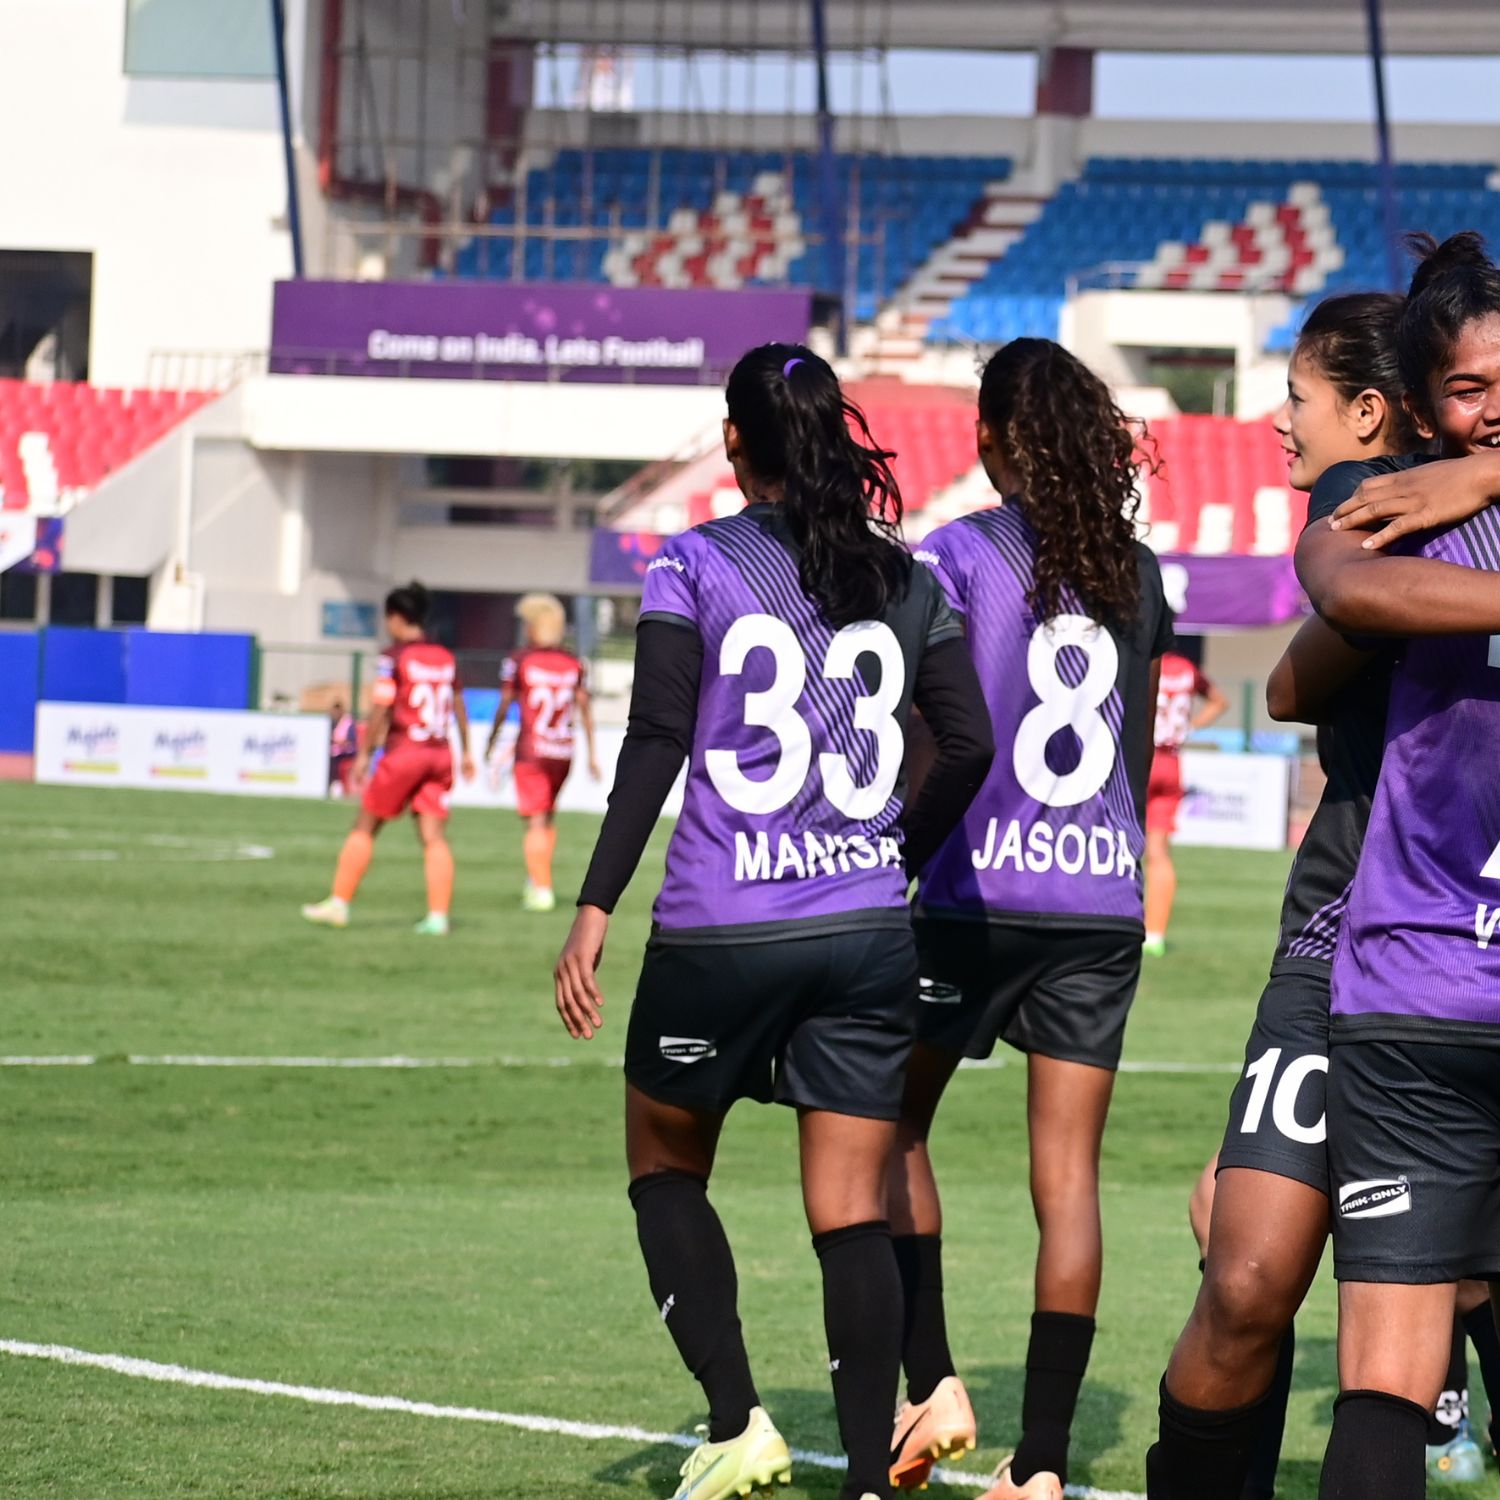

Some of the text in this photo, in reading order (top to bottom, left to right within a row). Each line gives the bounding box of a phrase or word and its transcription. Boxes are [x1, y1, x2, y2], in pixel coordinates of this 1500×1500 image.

[368, 329, 438, 360] Come
[440, 335, 473, 362] on
[602, 336, 704, 367] Football
[705, 612, 904, 820] 33
[1013, 613, 1119, 807] 8
[734, 831, 901, 881] MANISA
[971, 818, 1137, 880] JASODA
[1239, 1047, 1329, 1144] 10
[1340, 1184, 1407, 1213] TRAK-ONLY
